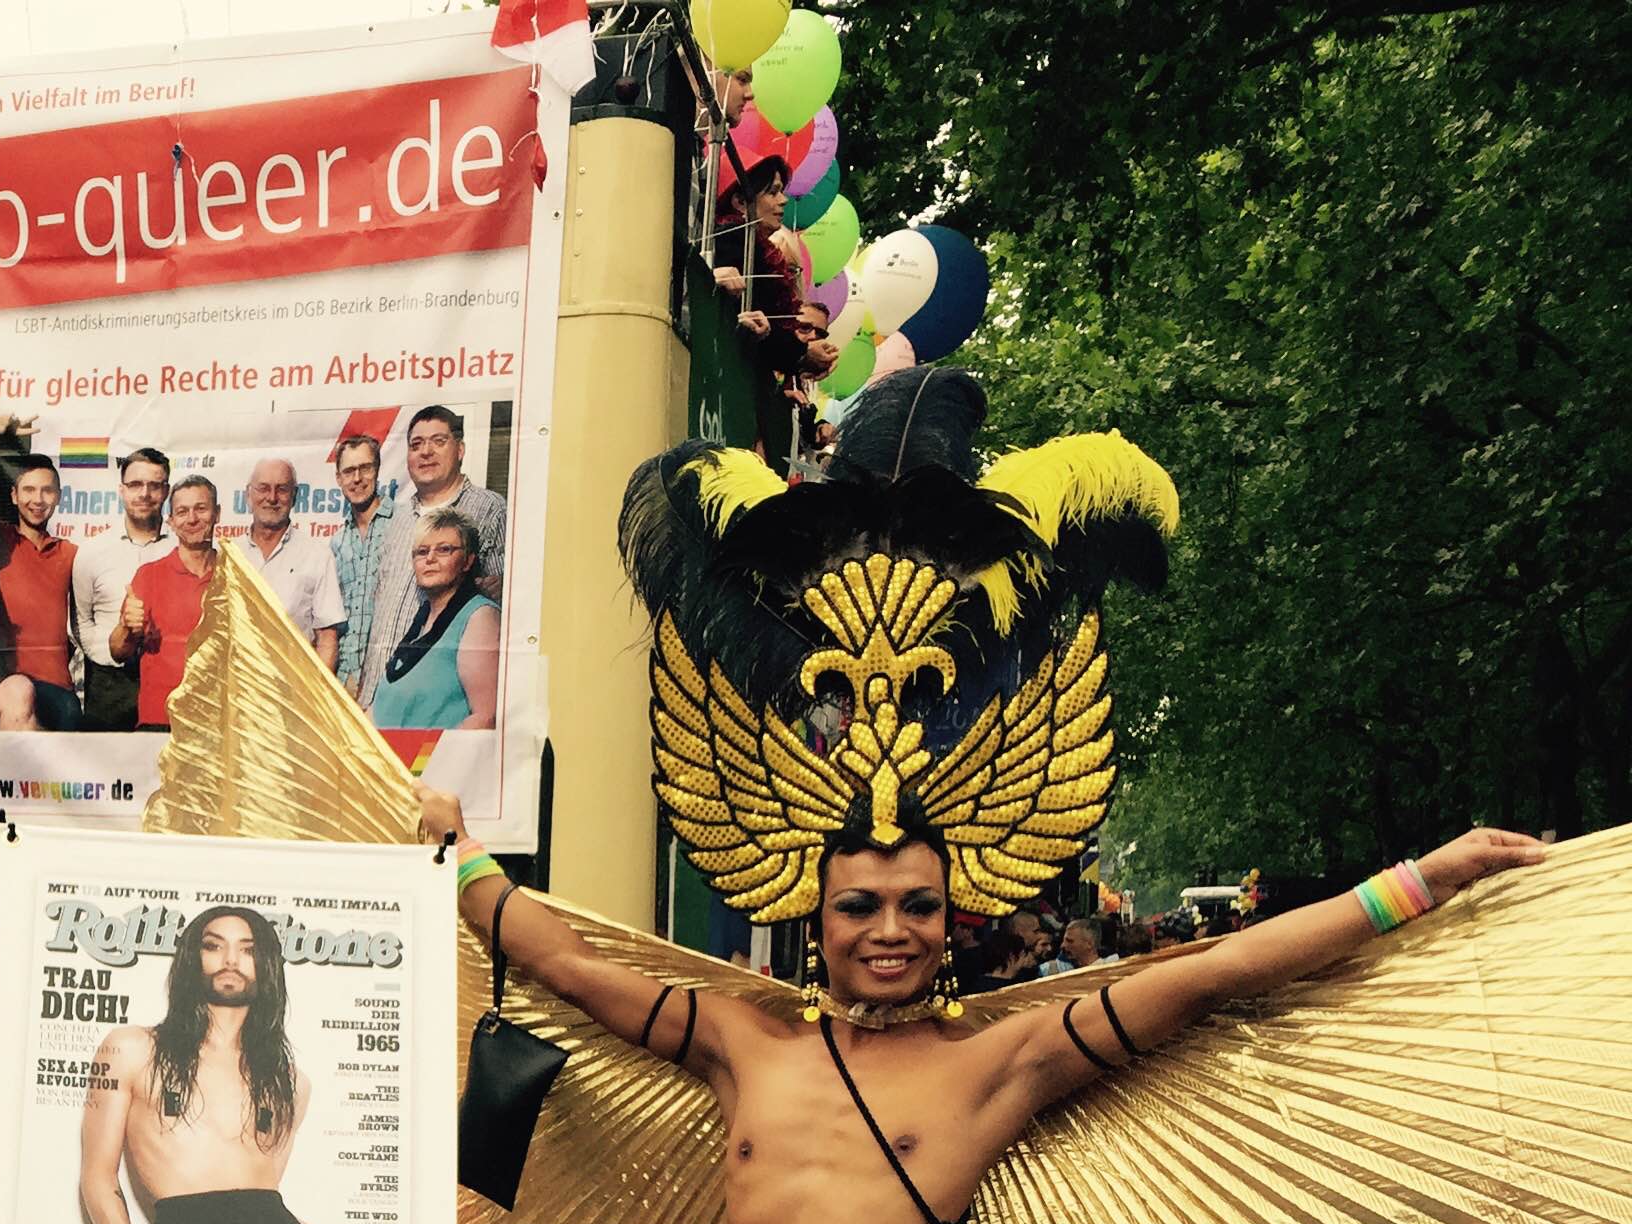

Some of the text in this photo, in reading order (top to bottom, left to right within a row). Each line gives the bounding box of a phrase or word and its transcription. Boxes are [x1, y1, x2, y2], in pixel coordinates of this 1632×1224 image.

[11, 86, 88, 112] Vielfalt
[95, 85, 121, 105] im
[129, 76, 196, 102] Beruf!
[14, 289, 521, 335] LSBT-Antidiskriminierungsarbeitskreis im DGB Bezirk Berlin-Brandenburg
[45, 367, 149, 406] gleiche
[160, 360, 259, 394] Rechte
[269, 363, 314, 389] am
[324, 346, 515, 387] Arbeitsplatz
[47, 883, 80, 896] MIT
[104, 886, 135, 899] AUF
[136, 888, 180, 901] TOUR
[195, 891, 277, 907] FLORENCE
[293, 897, 338, 910] TAME
[341, 898, 401, 912] IMPALA
[43, 966, 112, 990] TRAU
[41, 990, 130, 1024] DICH!
[354, 998, 401, 1009] SOUND
[371, 1010, 400, 1020] DER
[321, 1020, 400, 1032] REBELLION
[356, 1034, 400, 1053] 1965
[337, 1062, 400, 1073] BOB DYLAN
[36, 1073, 119, 1091] REVOLUTION
[375, 1085, 400, 1094] THE
[348, 1093, 400, 1102] BEATLES
[360, 1114, 400, 1123] JAMES
[357, 1122, 400, 1132] BROWN
[368, 1144, 399, 1153] JOHN
[337, 1151, 399, 1162] COLTRANE
[374, 1175, 399, 1184] THE
[360, 1183, 399, 1192] BYRDS
[344, 1211, 399, 1221] THE WHO
